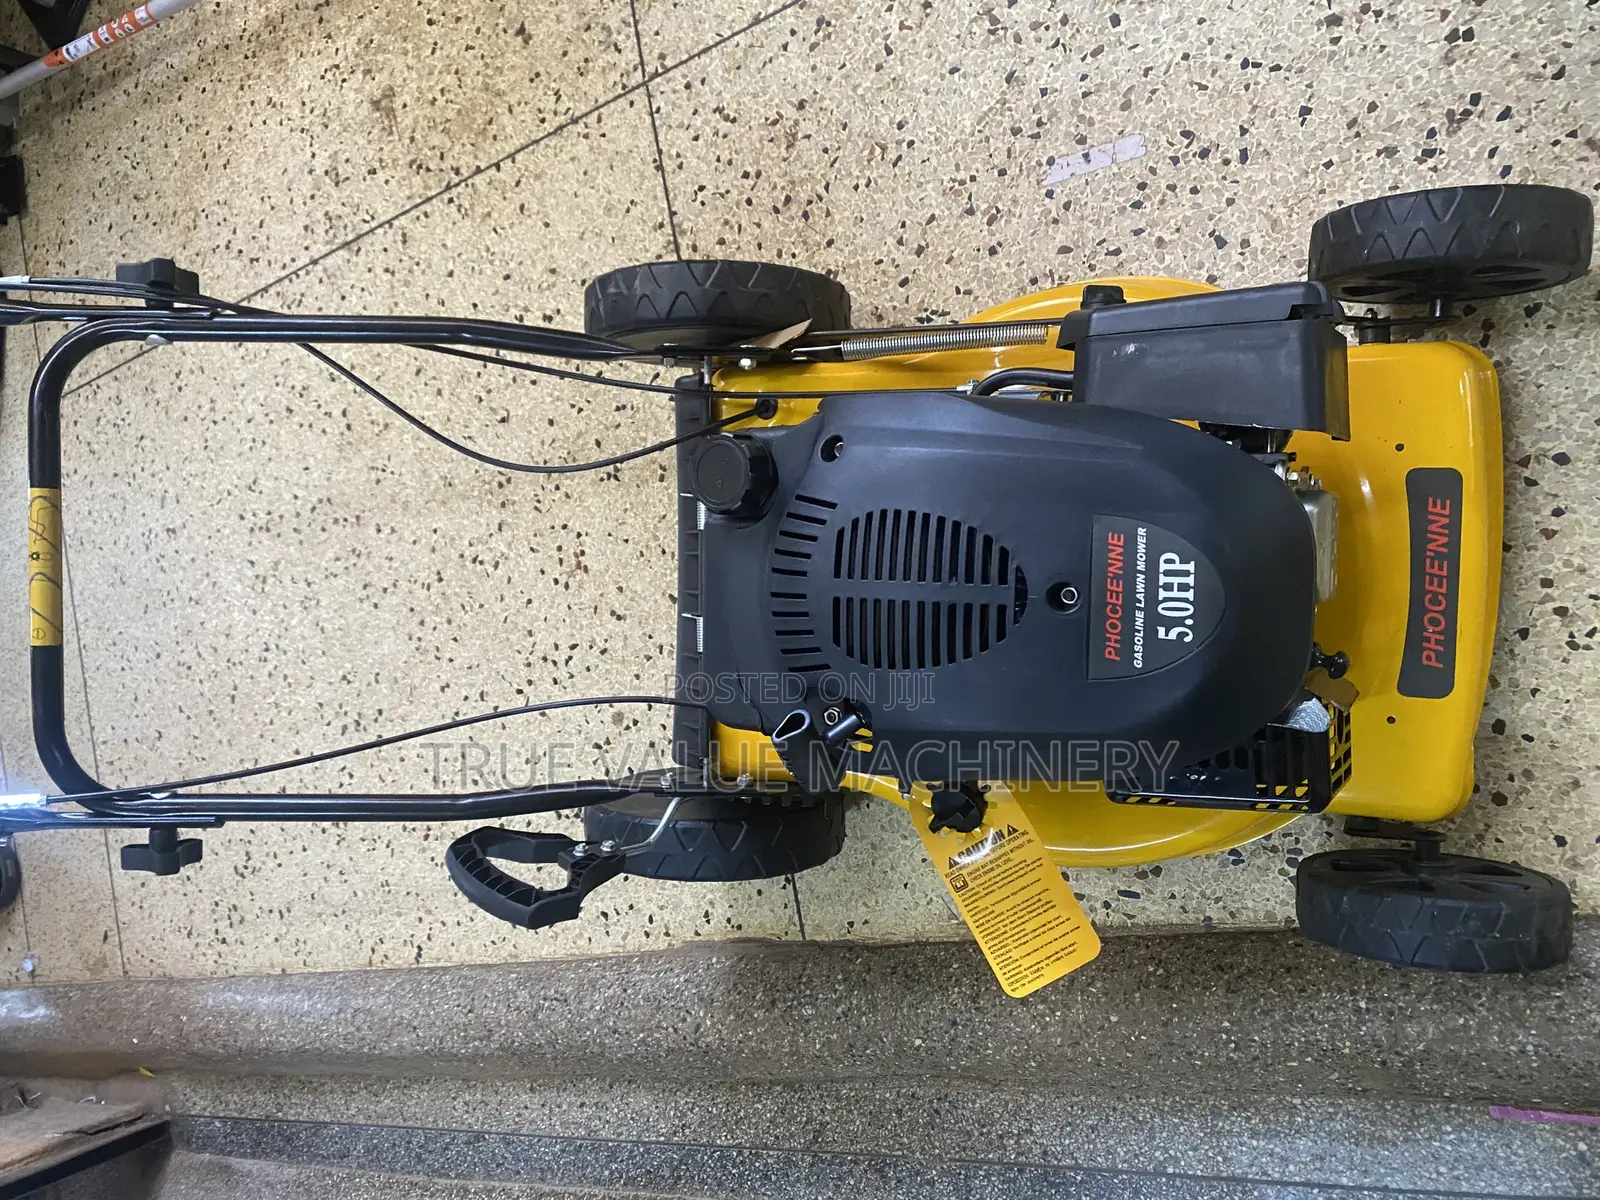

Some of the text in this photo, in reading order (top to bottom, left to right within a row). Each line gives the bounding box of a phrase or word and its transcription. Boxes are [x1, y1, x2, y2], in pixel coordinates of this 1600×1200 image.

[1104, 532, 1124, 661] PHOCEE'NNE
[1133, 527, 1147, 668] GASOLINE LAWN MOWER
[1157, 552, 1195, 642] 5.0HP
[1421, 496, 1450, 669] PHOCEE'NNE
[955, 828, 1006, 862] CAUTON
